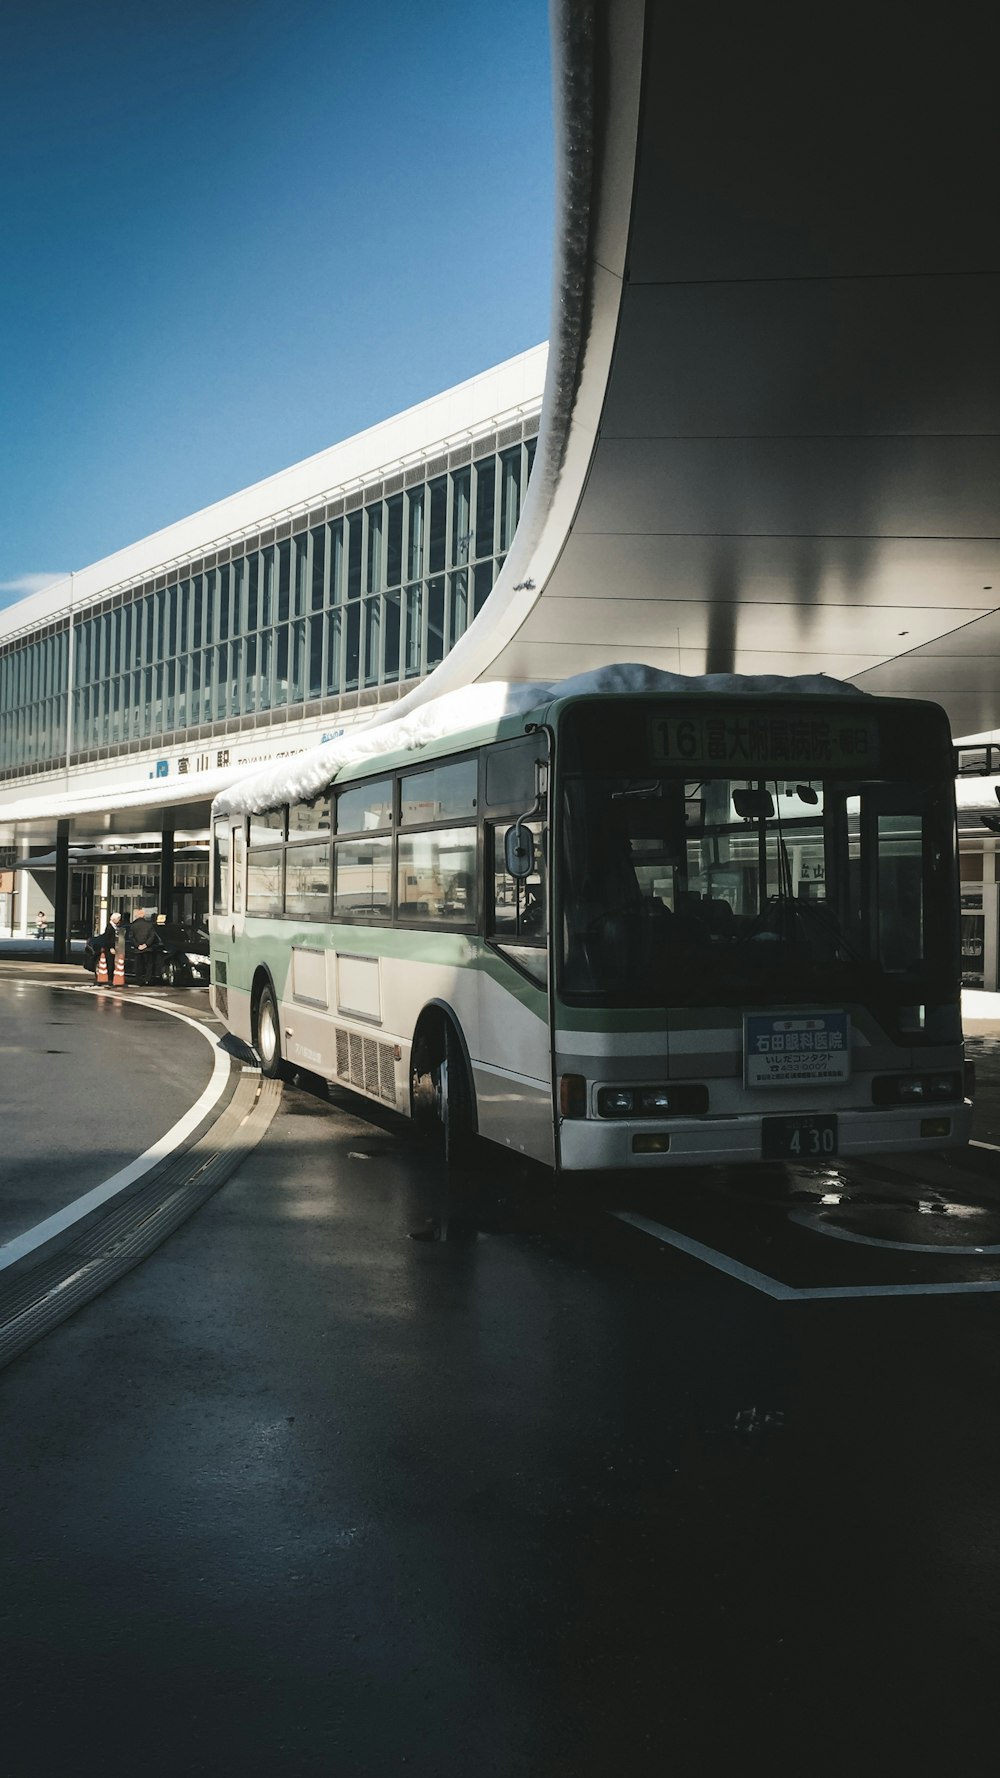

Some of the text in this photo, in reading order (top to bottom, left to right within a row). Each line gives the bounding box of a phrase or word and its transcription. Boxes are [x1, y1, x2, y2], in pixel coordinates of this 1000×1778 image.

[656, 720, 698, 757] 16
[756, 1031, 843, 1052] 石田眼科医院
[765, 1052, 833, 1064] いしだコンタクト
